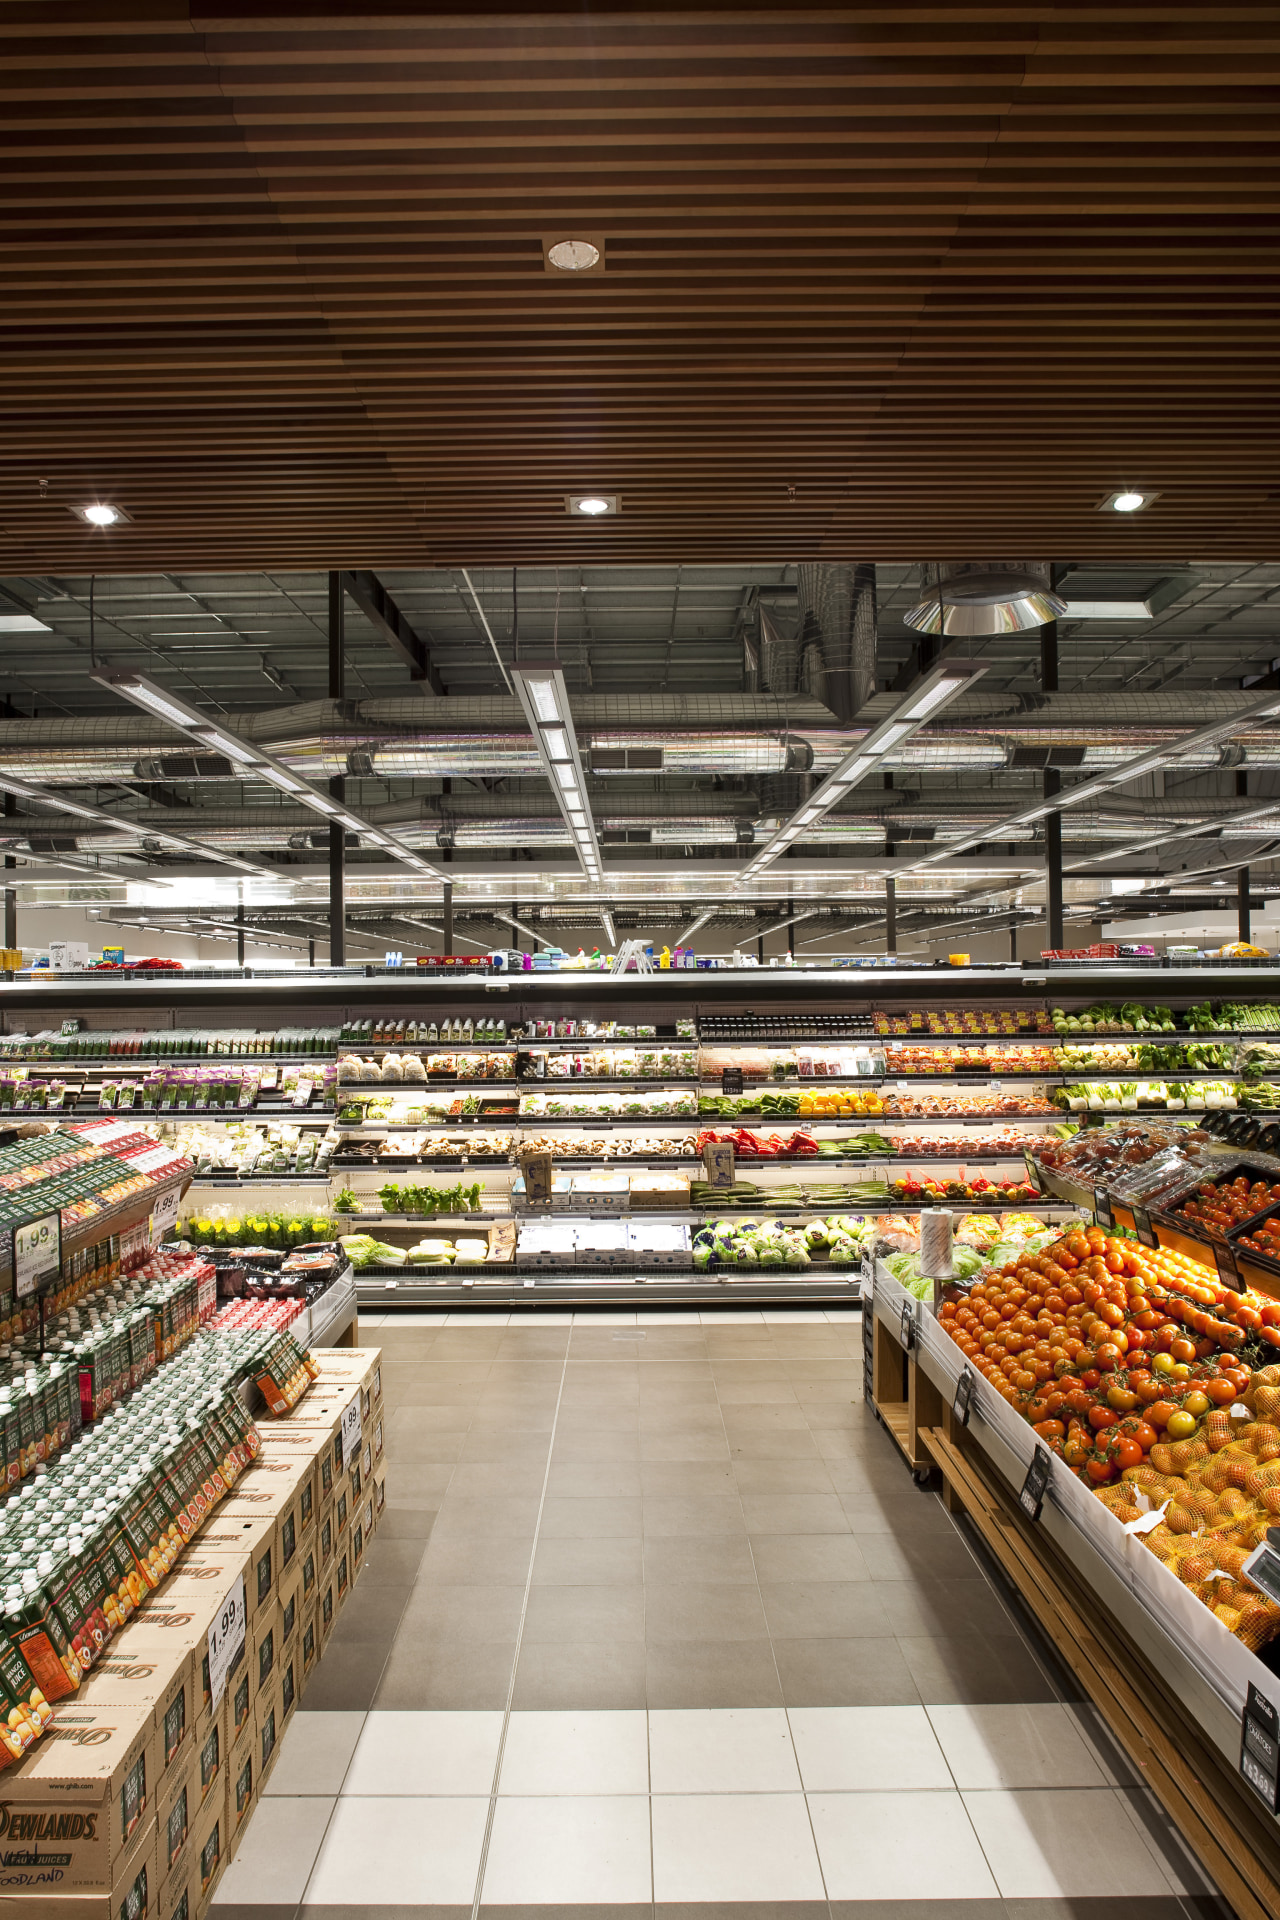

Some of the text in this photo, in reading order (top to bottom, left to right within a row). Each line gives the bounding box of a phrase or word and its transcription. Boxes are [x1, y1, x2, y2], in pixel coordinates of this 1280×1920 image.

[155, 1194, 174, 1214] 1.99
[17, 1225, 49, 1253] 1.99
[342, 1406, 357, 1434] 1.99
[210, 1599, 236, 1655] 1.99
[5, 1660, 22, 1681] MANGO
[10, 1667, 27, 1689] JUICE
[1247, 1720, 1272, 1755] TOMATOES
[37, 1855, 68, 1865] JUICES
